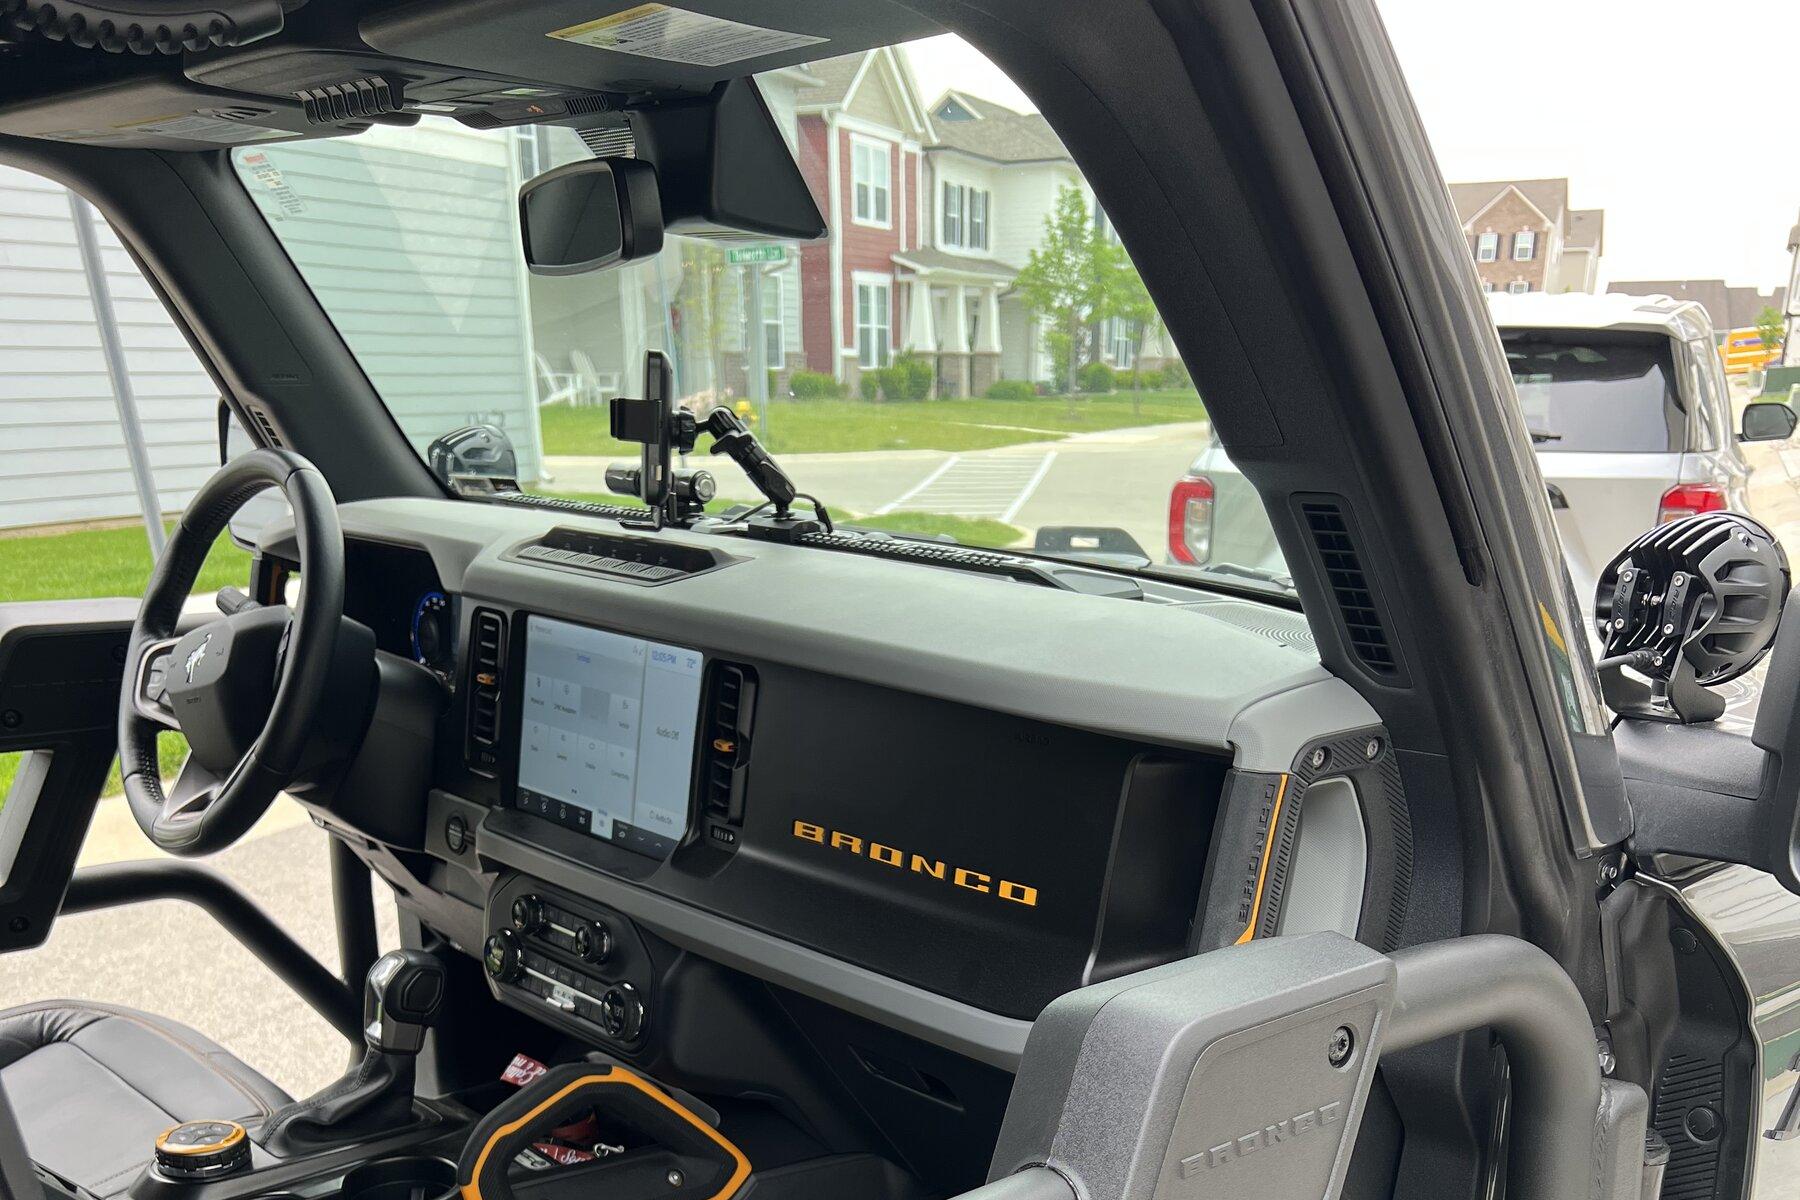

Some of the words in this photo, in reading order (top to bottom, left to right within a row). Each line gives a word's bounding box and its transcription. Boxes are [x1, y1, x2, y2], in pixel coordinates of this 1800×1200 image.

[793, 820, 1038, 907] BRONCO
[1239, 783, 1276, 924] BRONCO
[1178, 1100, 1341, 1180] BRONCO
